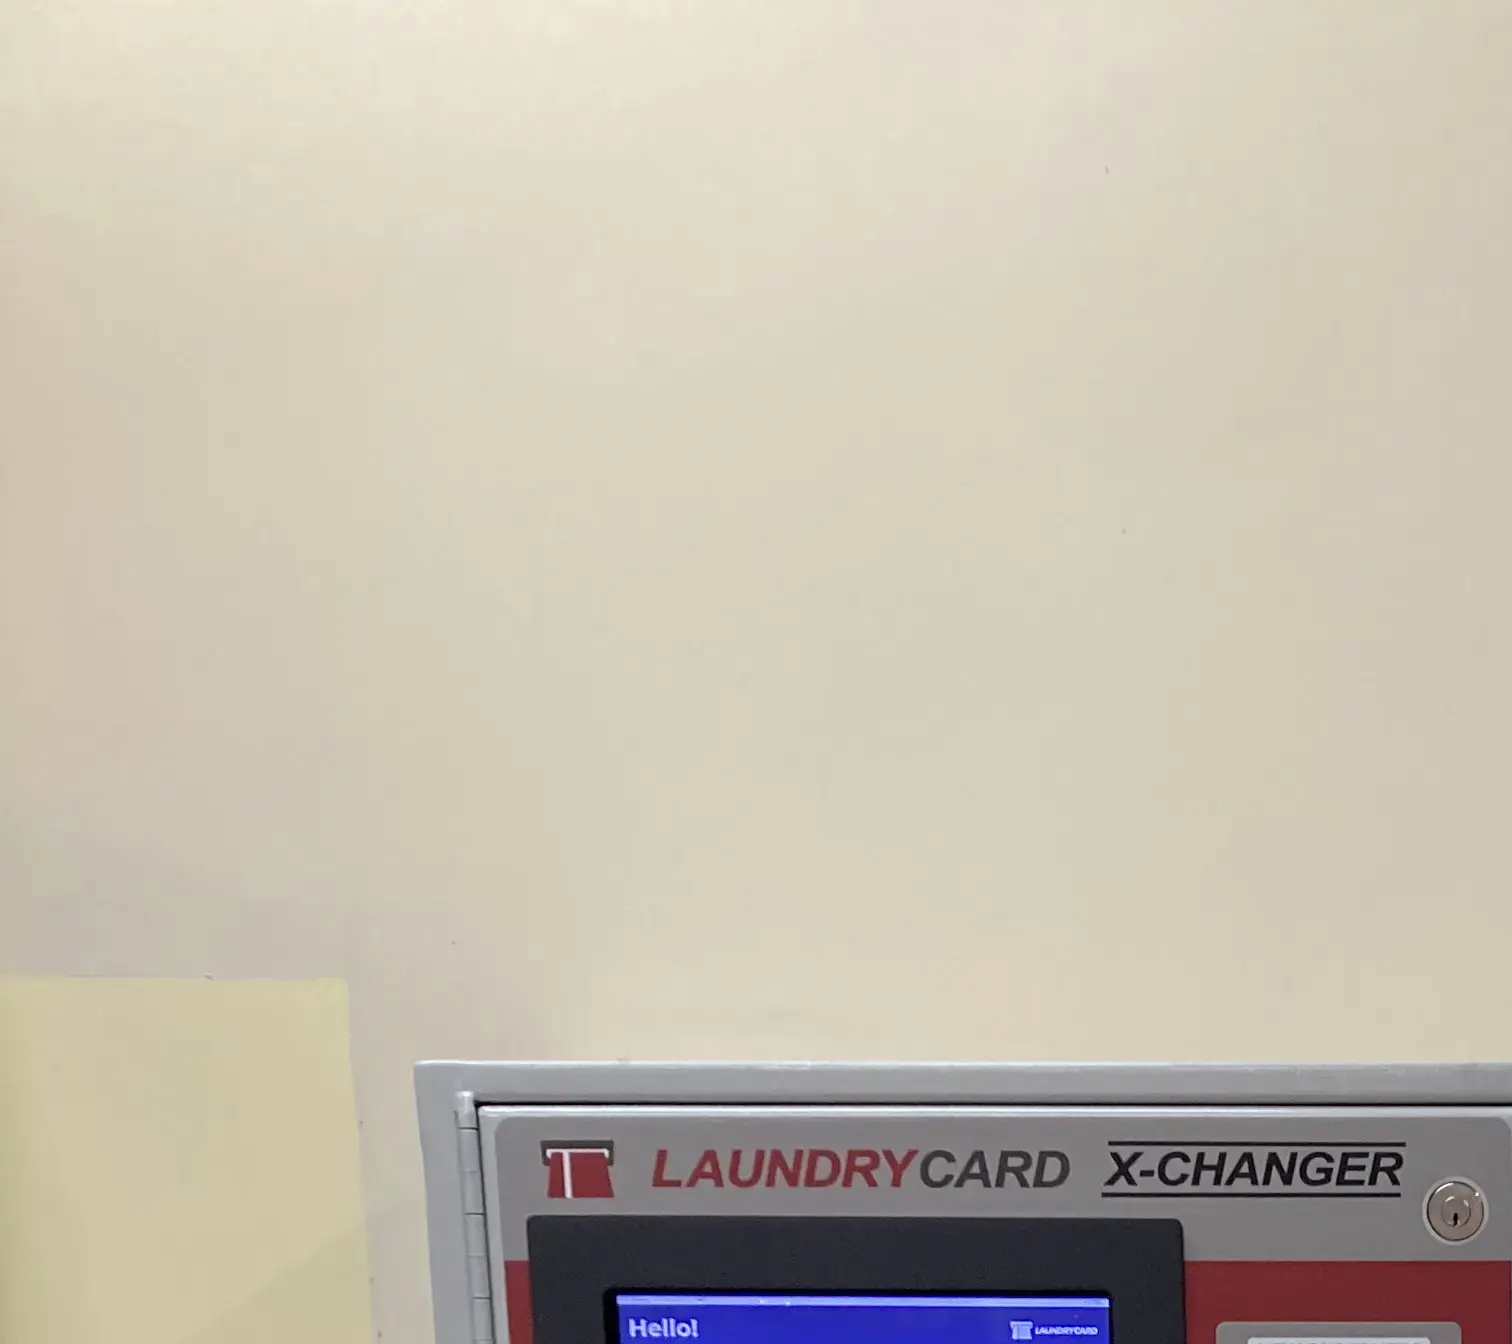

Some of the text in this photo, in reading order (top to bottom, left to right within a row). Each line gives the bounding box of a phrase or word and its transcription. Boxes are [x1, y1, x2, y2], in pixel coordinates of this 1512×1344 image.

[651, 1149, 1404, 1188] LAUNDRYCARD X-CHANGER
[628, 1318, 699, 1338] Hello!
